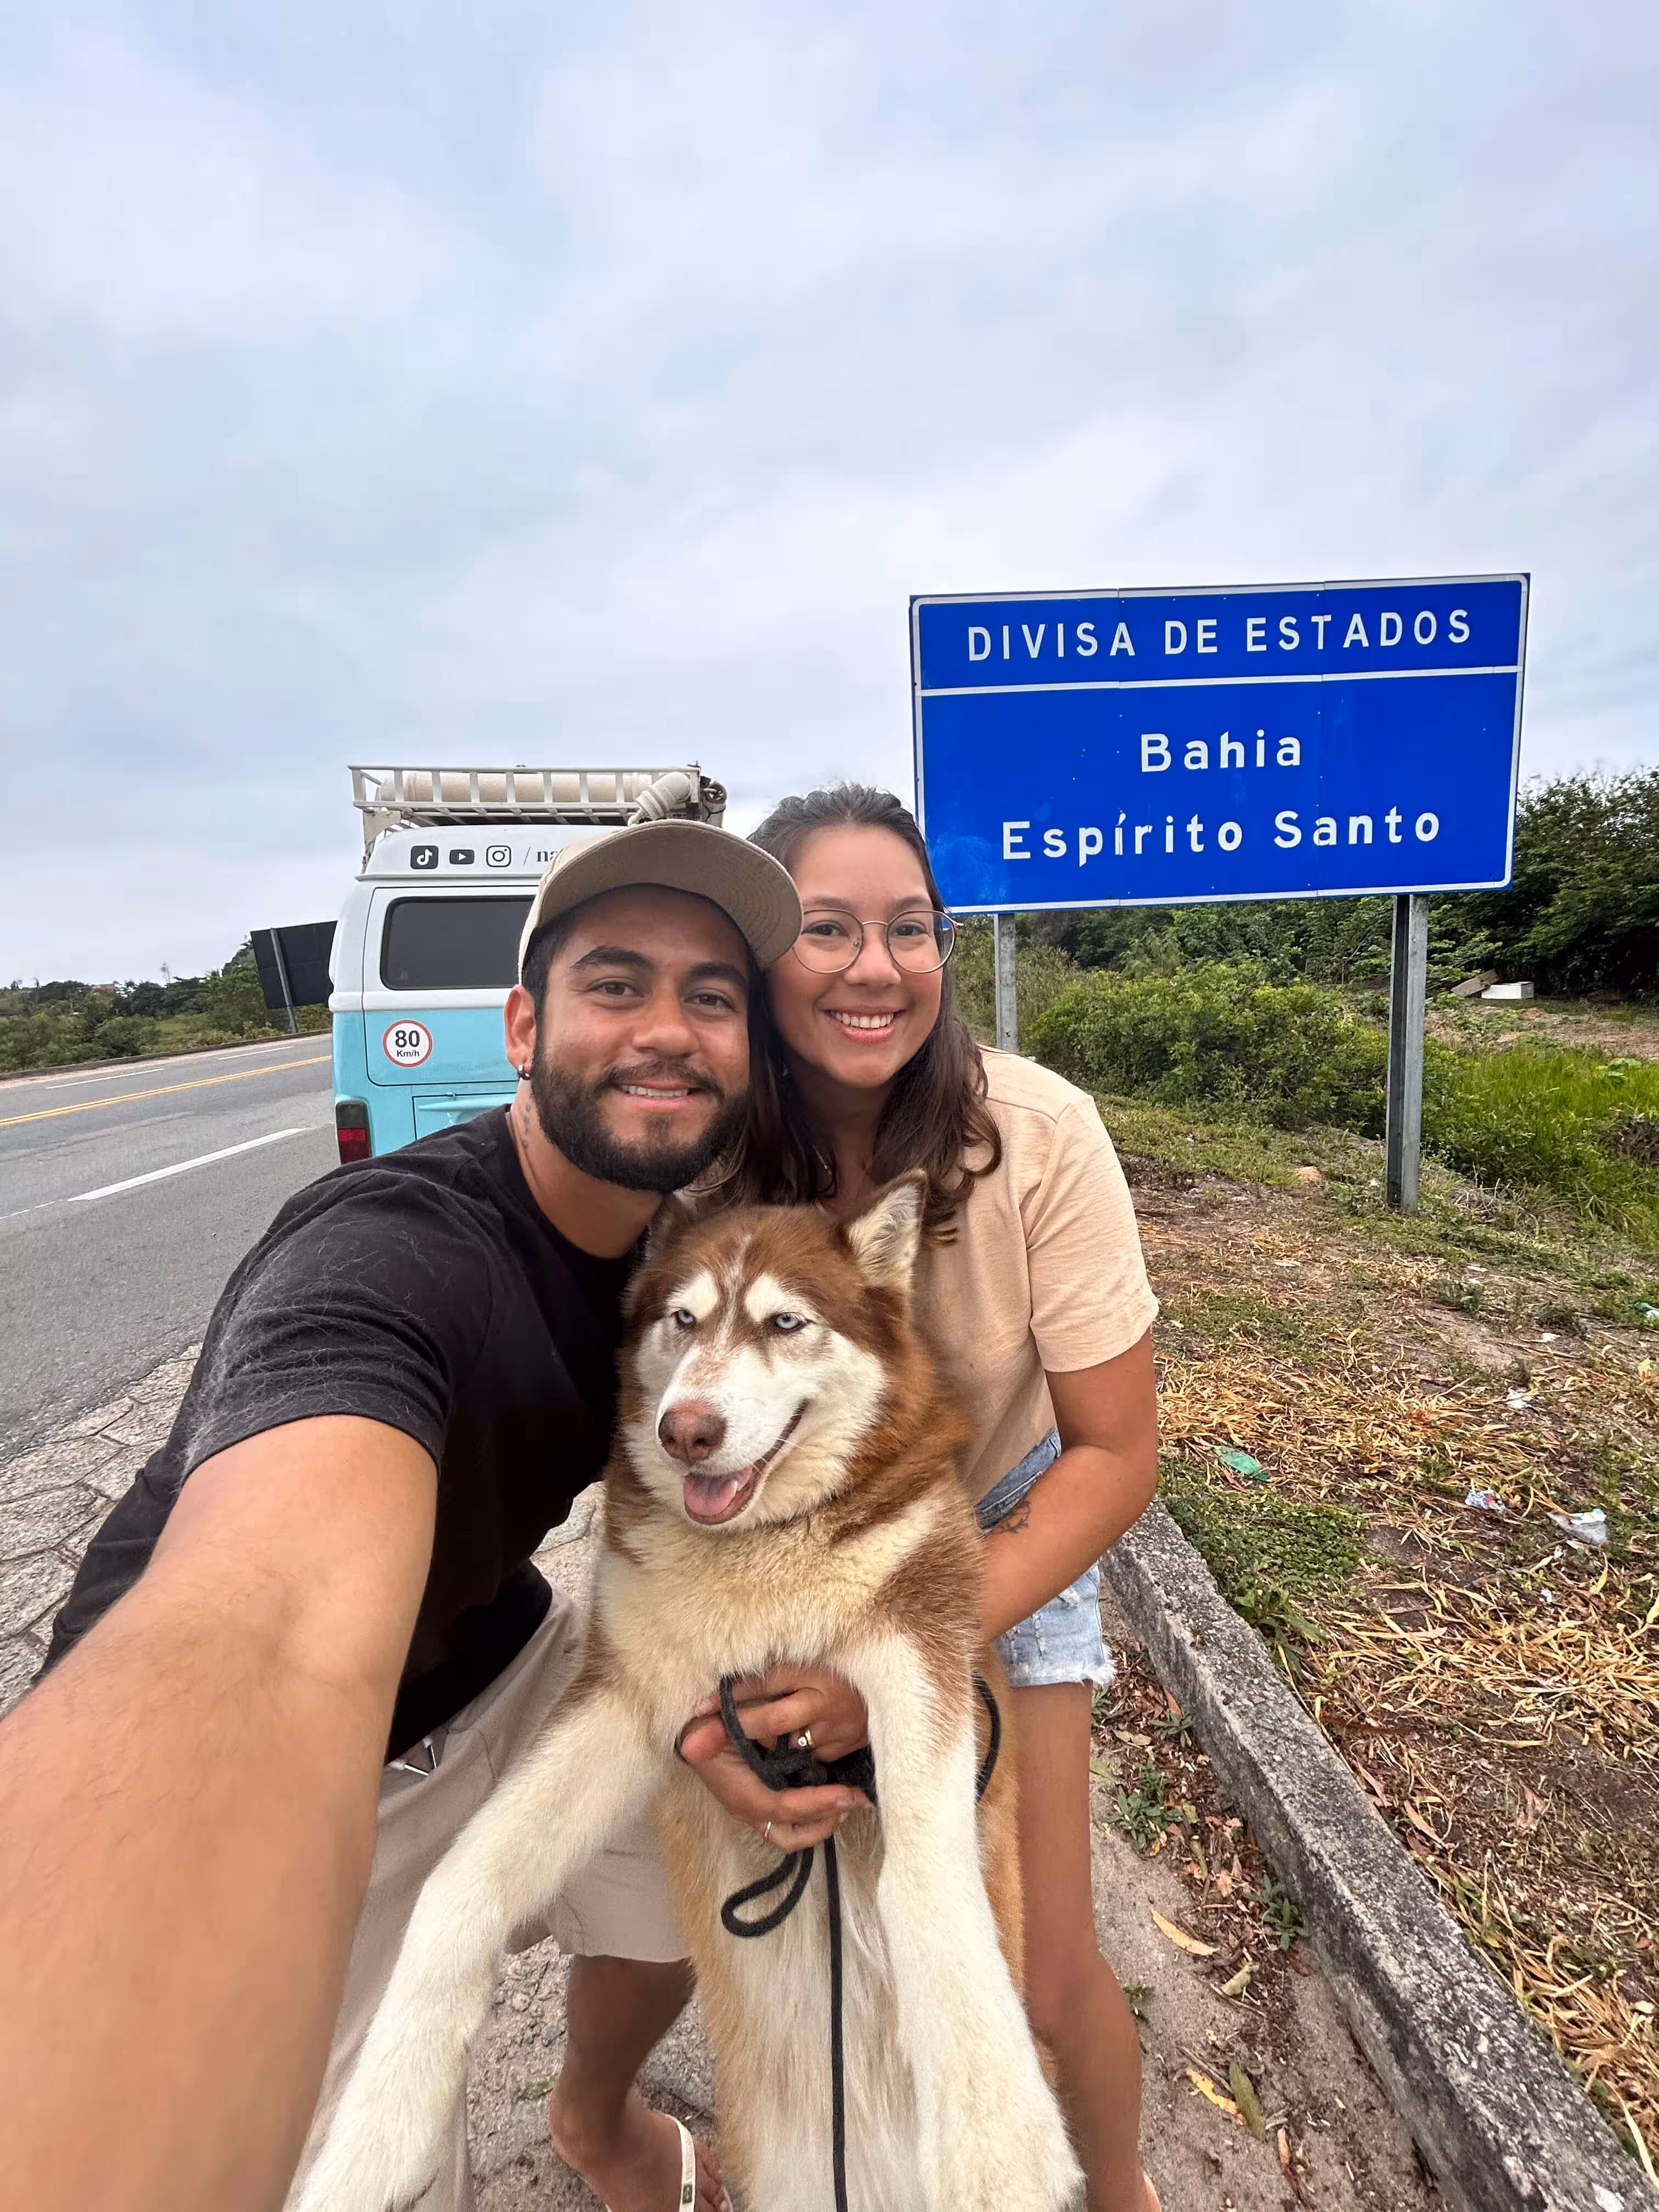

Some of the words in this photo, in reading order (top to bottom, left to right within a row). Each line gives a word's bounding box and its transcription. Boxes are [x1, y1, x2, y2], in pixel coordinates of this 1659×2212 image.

[968, 622, 1136, 662] DIVISA
[1164, 618, 1218, 655] DE
[1246, 608, 1470, 652] ESTADOS
[1141, 729, 1301, 773] Bahia
[1002, 812, 1243, 868] Espírito
[1273, 805, 1440, 849] Santo
[395, 1030, 420, 1048] 80
